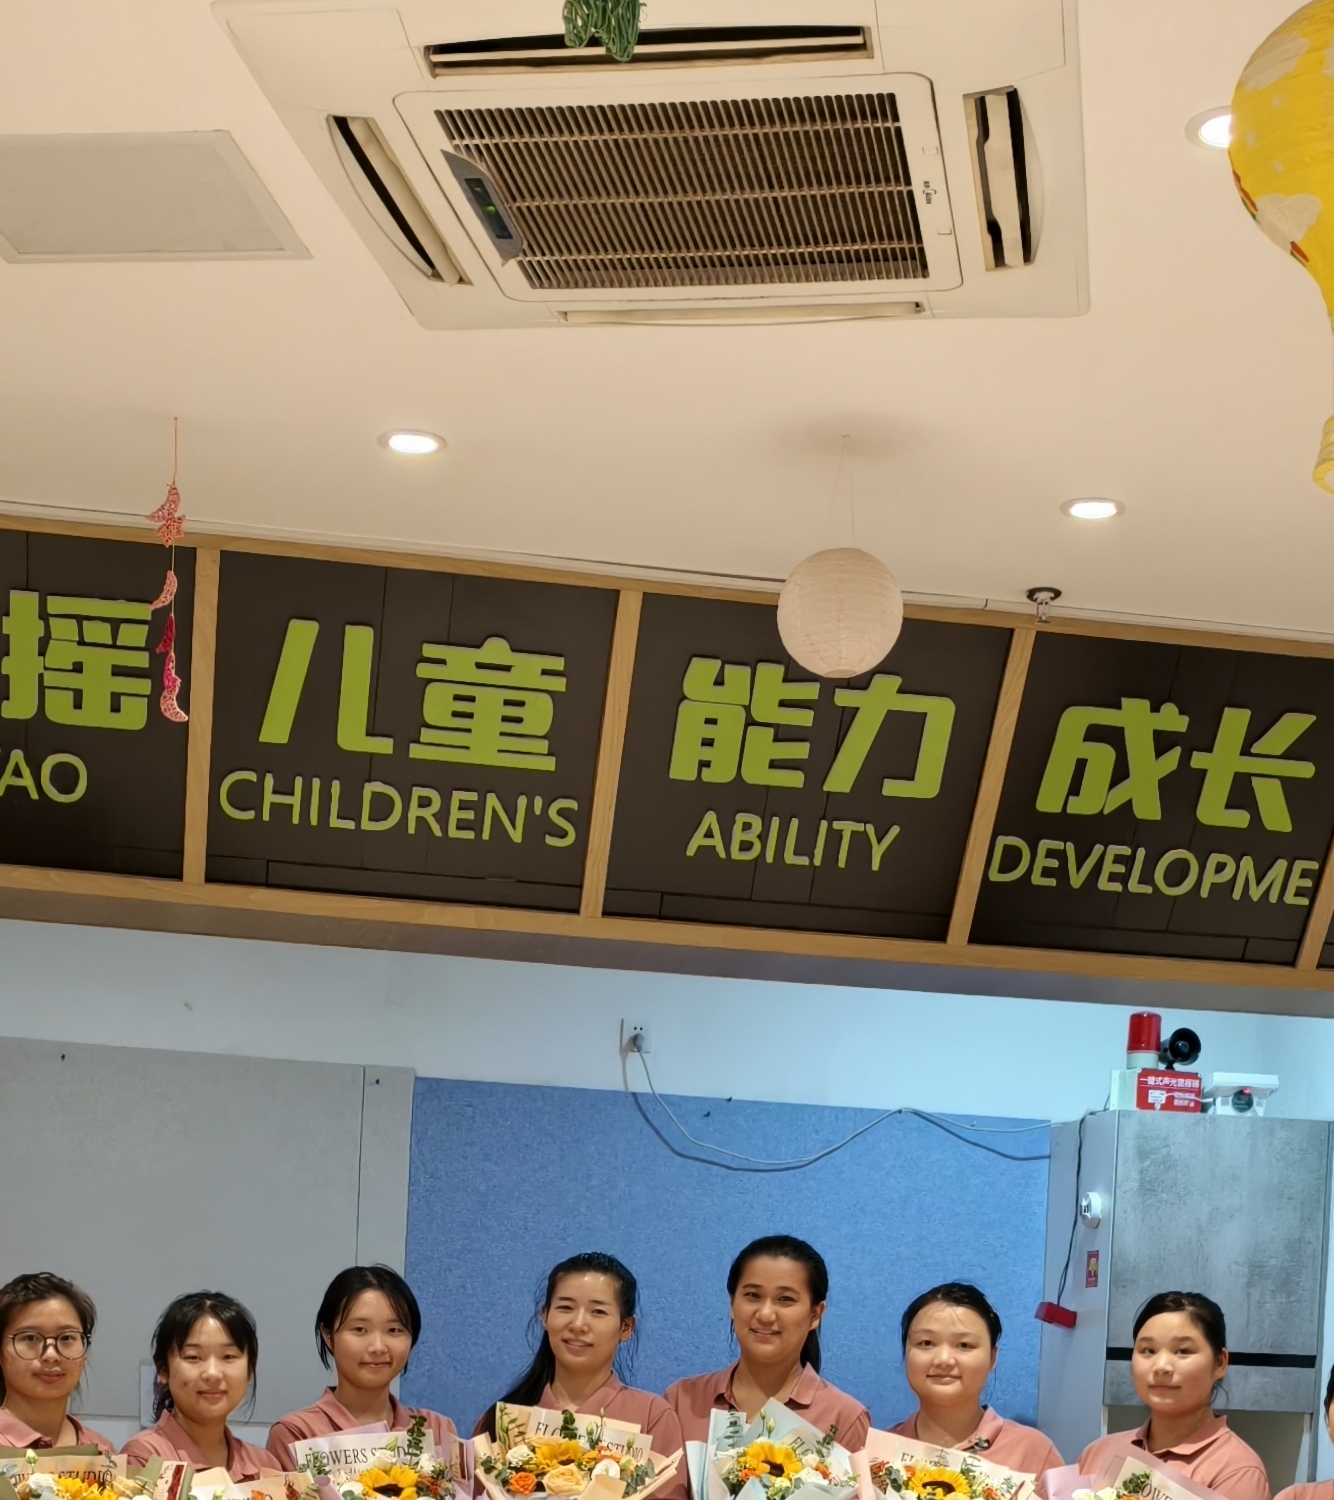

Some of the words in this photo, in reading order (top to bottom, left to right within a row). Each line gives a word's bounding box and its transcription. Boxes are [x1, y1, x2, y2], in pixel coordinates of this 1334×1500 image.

[257, 618, 567, 771] 儿童
[668, 657, 957, 801] 能力
[1035, 697, 1317, 833] 成长
[219, 769, 579, 849] CHILDREN'S
[685, 811, 901, 874] ABILITY
[986, 836, 1320, 907] DEVELOPME
